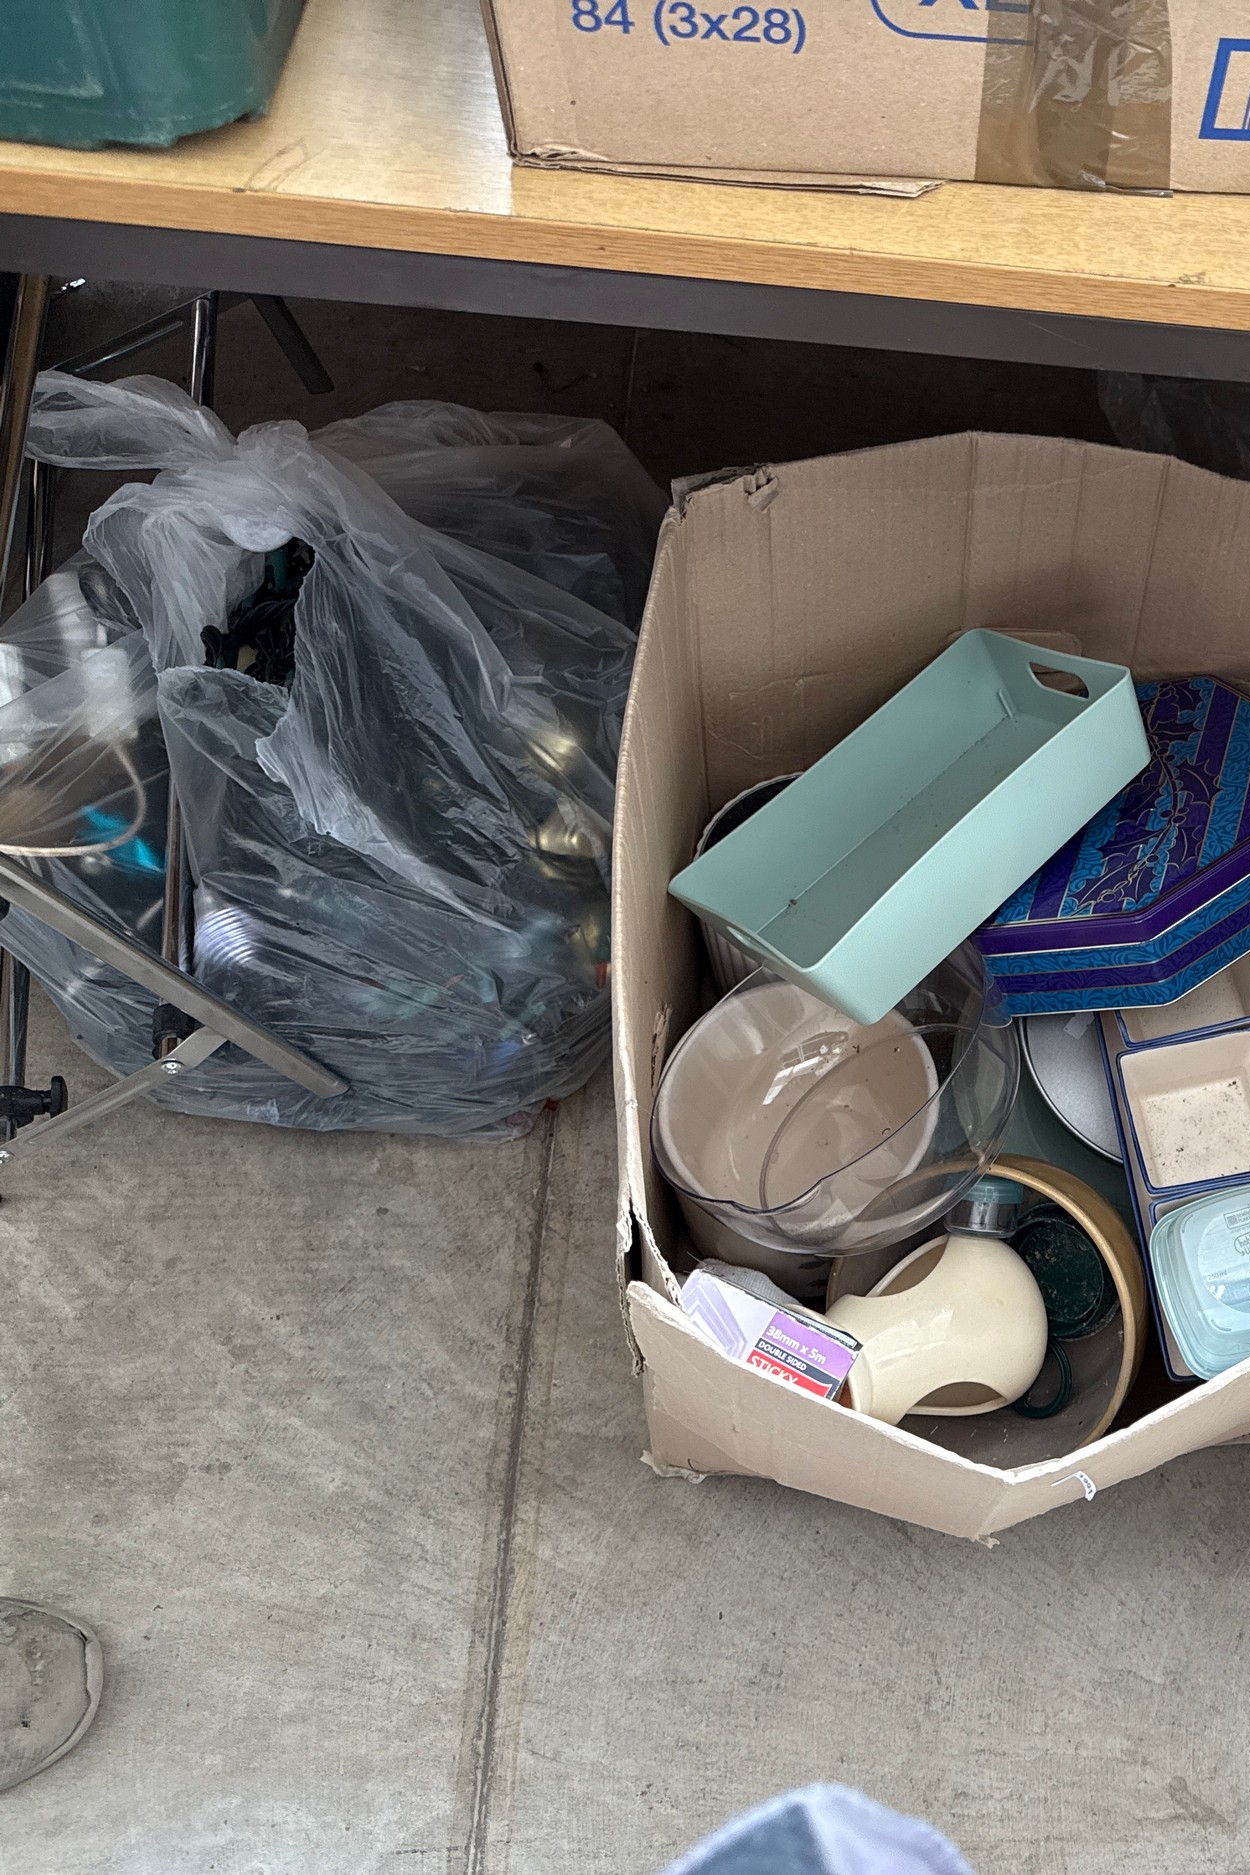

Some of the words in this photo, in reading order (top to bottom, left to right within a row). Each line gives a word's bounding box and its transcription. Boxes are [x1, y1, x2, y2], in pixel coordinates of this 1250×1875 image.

[571, 0, 635, 34] 84
[653, 0, 807, 54] (3x28)
[758, 1341, 787, 1360] DOUBLE
[786, 1356, 807, 1371] SIDED
[766, 1325, 800, 1350] 38mm
[799, 1344, 809, 1355] x
[807, 1347, 827, 1365] 5m
[751, 1355, 800, 1384] STICKY
